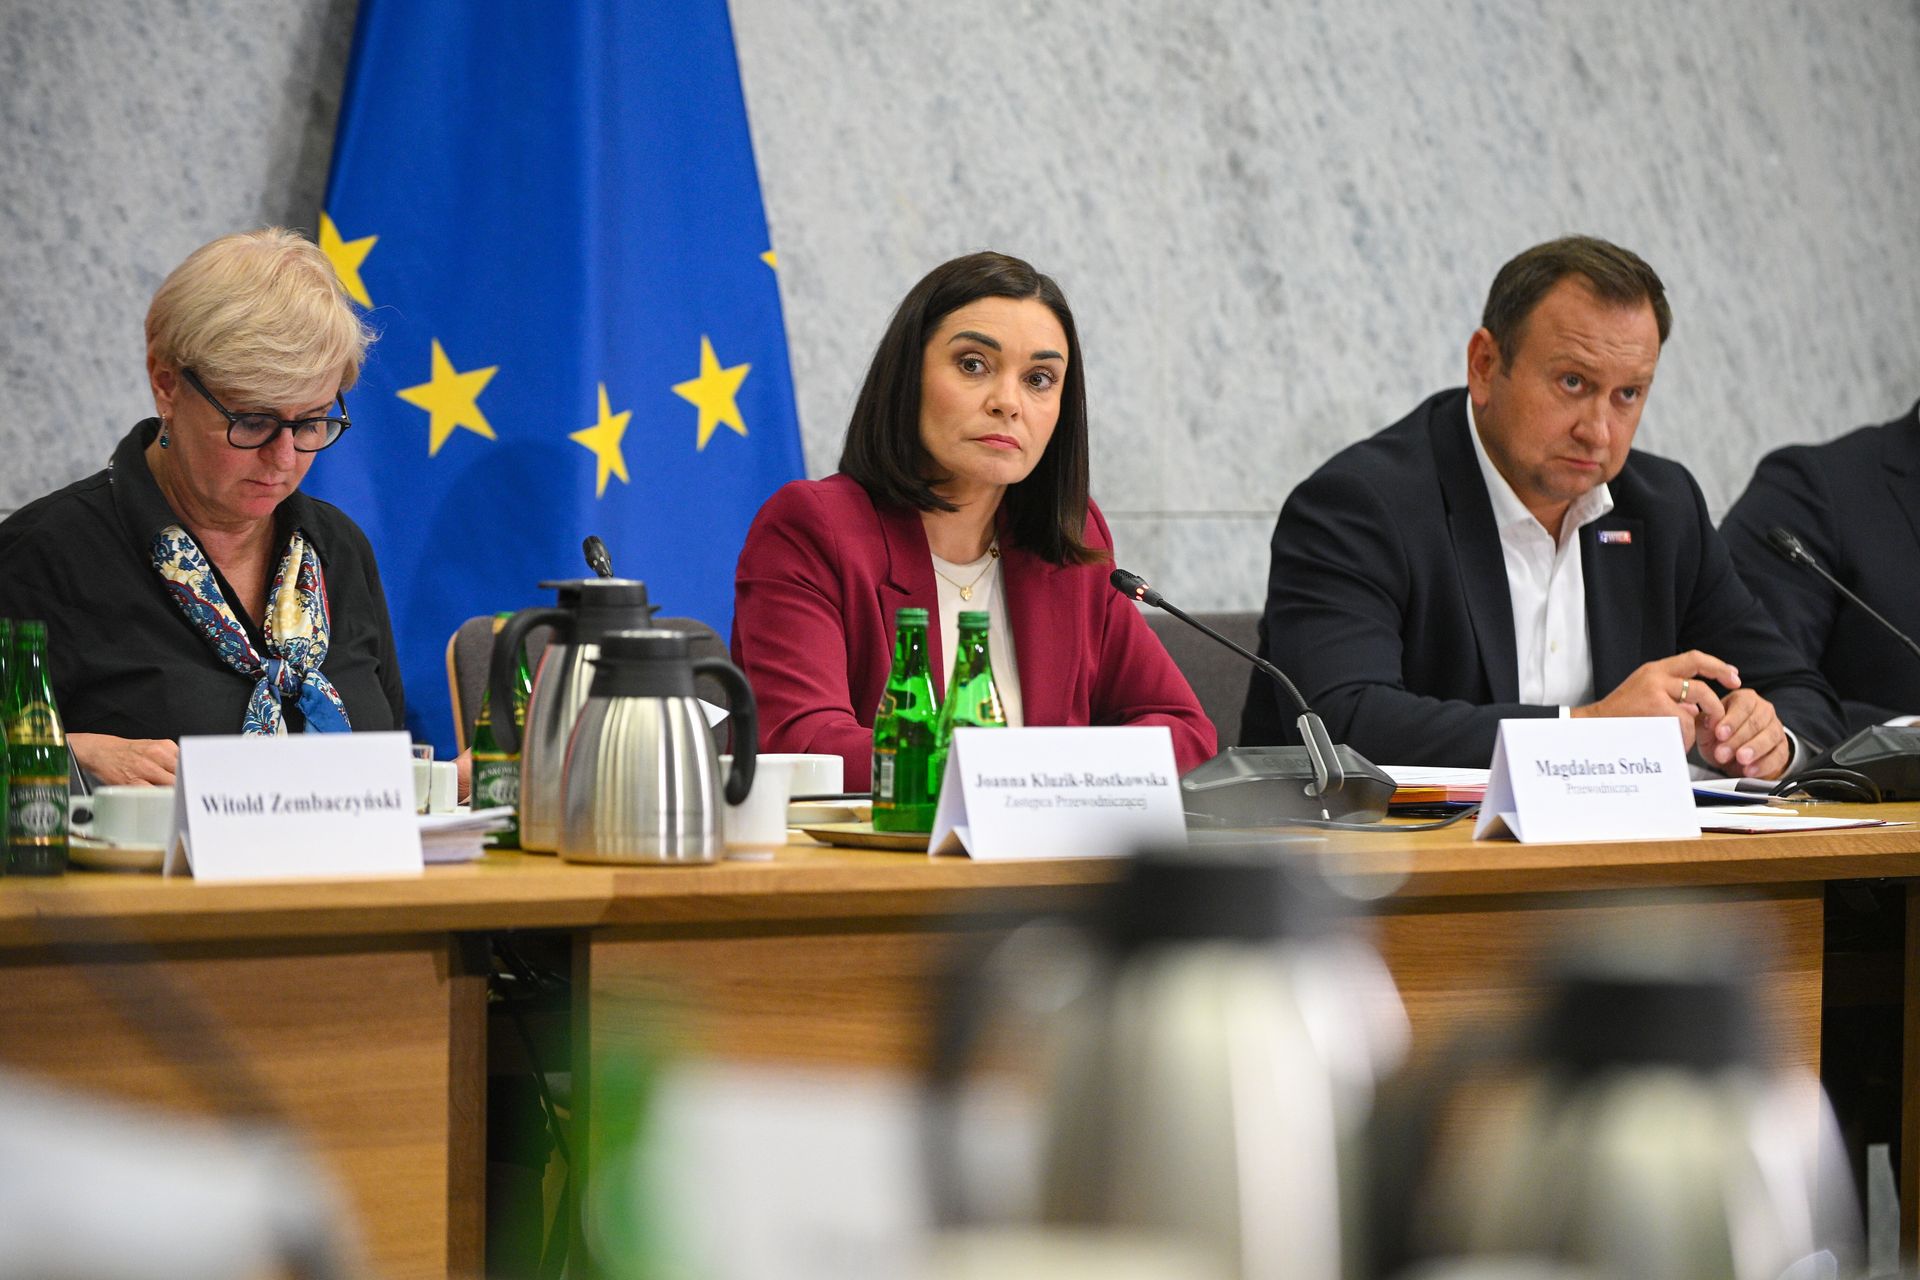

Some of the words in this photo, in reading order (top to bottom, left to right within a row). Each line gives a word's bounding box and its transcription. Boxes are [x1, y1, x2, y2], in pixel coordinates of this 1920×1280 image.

[975, 773, 1026, 788] Joanna
[1031, 771, 1169, 788] Kluzik-Rostkowska
[1535, 759, 1615, 780] Magdalena
[1618, 757, 1662, 775] Sroka
[200, 793, 263, 815] Witold
[269, 789, 401, 816] Zembaczyński
